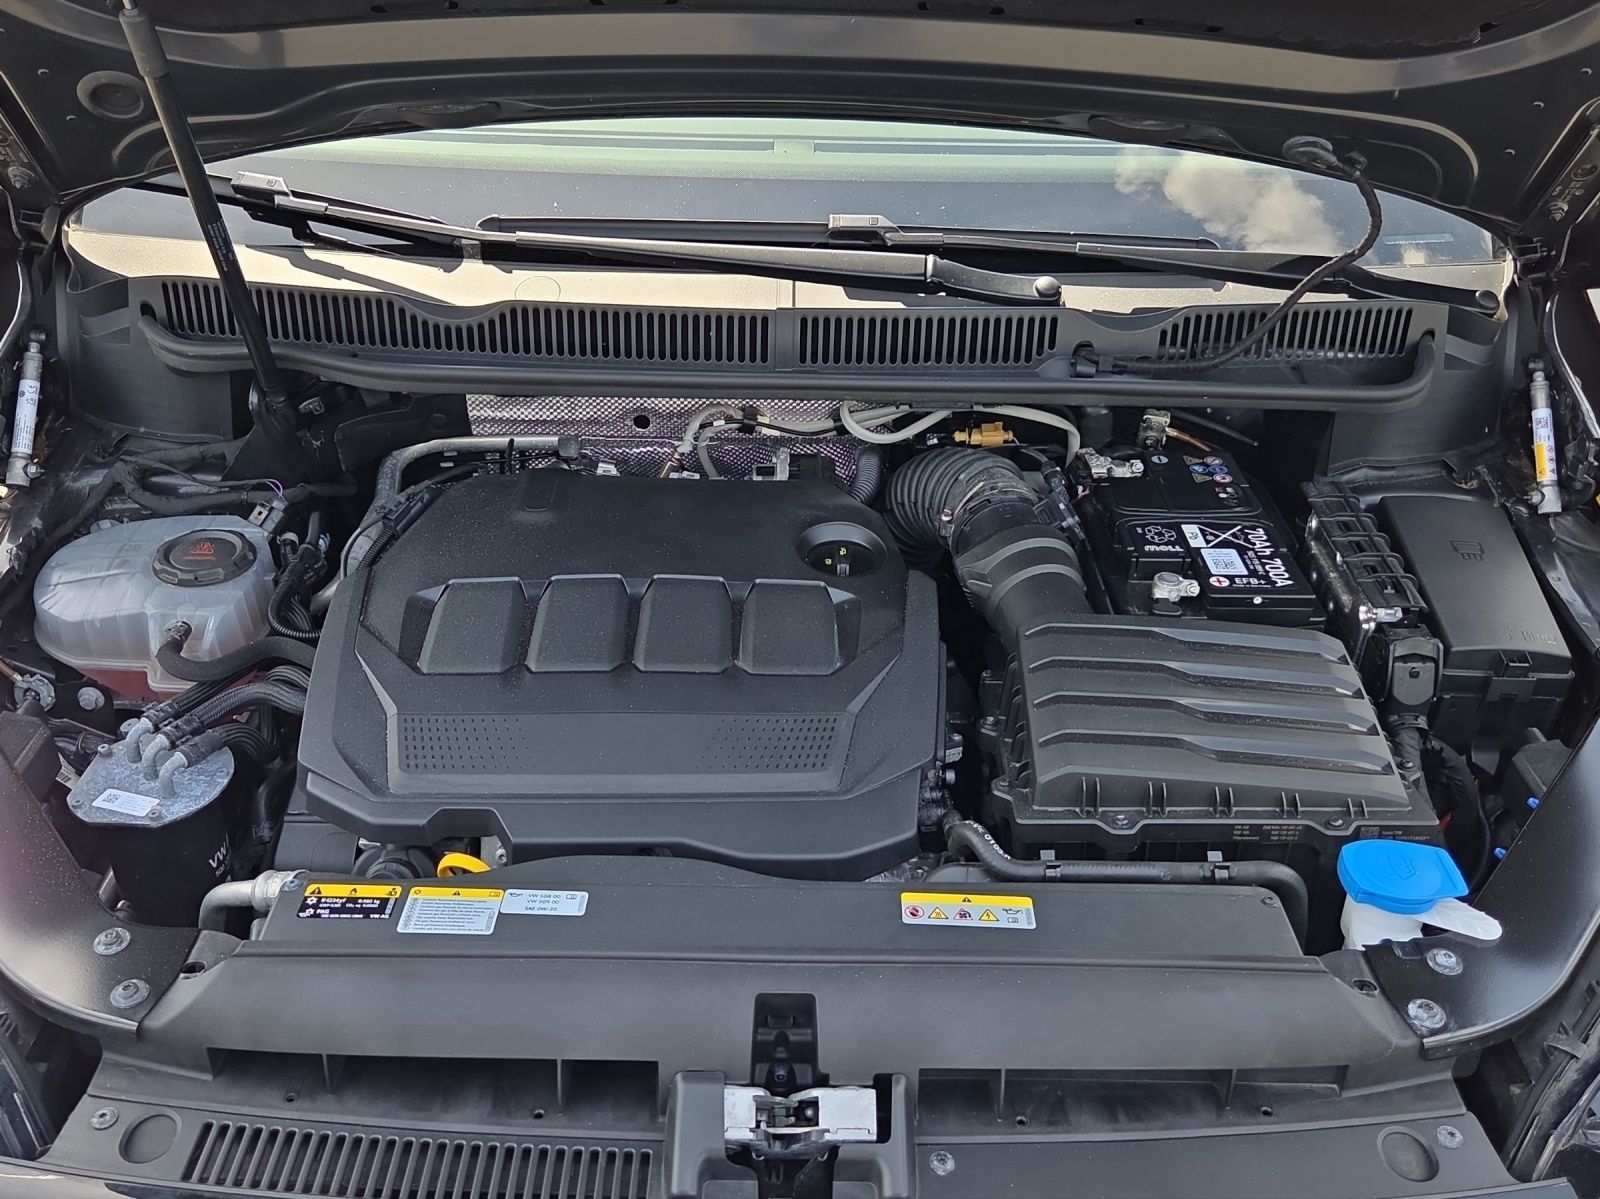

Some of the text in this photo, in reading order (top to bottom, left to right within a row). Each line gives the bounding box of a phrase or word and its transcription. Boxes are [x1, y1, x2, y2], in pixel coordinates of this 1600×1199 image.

[1244, 527, 1275, 556] 70Ah
[1261, 557, 1295, 588] 700A
[209, 841, 227, 868] VW
